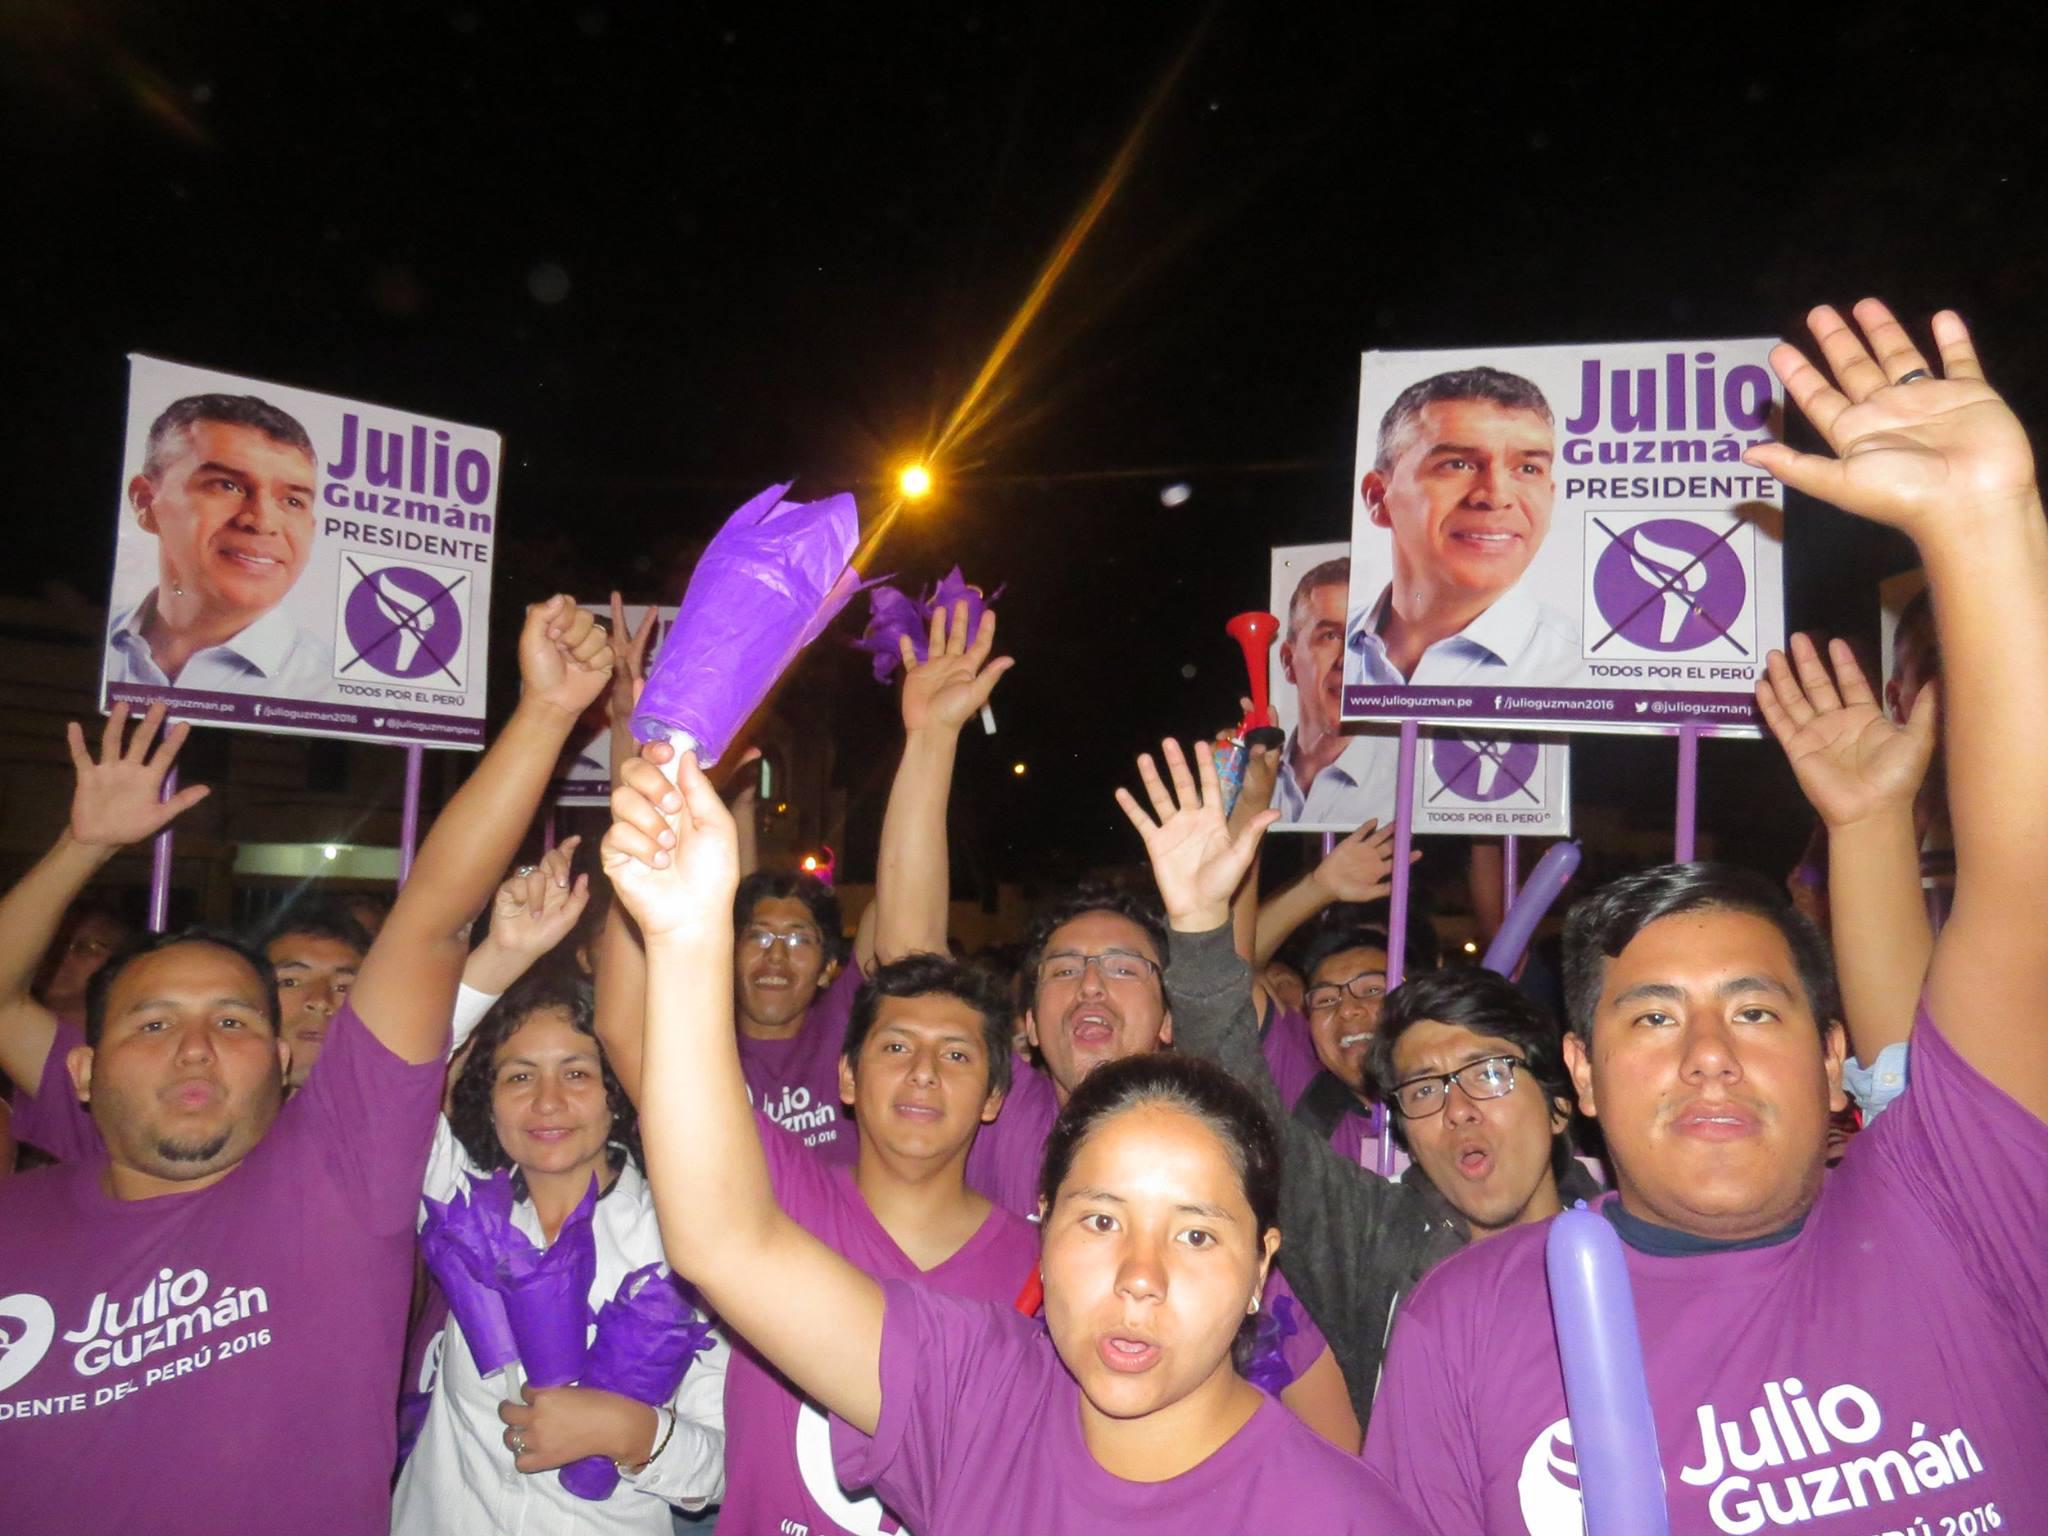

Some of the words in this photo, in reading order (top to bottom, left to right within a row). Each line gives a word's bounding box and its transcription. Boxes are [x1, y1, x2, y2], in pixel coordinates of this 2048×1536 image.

[1565, 352, 1773, 435] Julio
[327, 413, 490, 505] Julio
[323, 483, 491, 534] Guzmán
[1566, 476, 1775, 499] PRESIDENTE
[325, 517, 488, 562] PRESIDENTE
[338, 684, 381, 698] TODOS
[385, 691, 412, 701] POR
[415, 693, 429, 703] EL
[432, 695, 465, 706] PERÚ
[1589, 665, 1642, 677] TODOS
[1648, 666, 1681, 678] POR
[1687, 667, 1705, 679] EL
[1710, 666, 1755, 680] PERÚ
[1350, 696, 1472, 709] www.julioguzman.pe
[1427, 812, 1465, 822] TODOS
[1468, 813, 1492, 823] POR
[1496, 813, 1509, 823] EL
[1512, 812, 1543, 824] PERÚ
[63, 1268, 209, 1343] Julio
[74, 1286, 268, 1376] Guzmán
[146, 1345, 212, 1386] PERÚ
[218, 1328, 272, 1360] 2016
[1680, 1377, 1882, 1486] Julio
[1708, 1421, 1984, 1536] Guzmán
